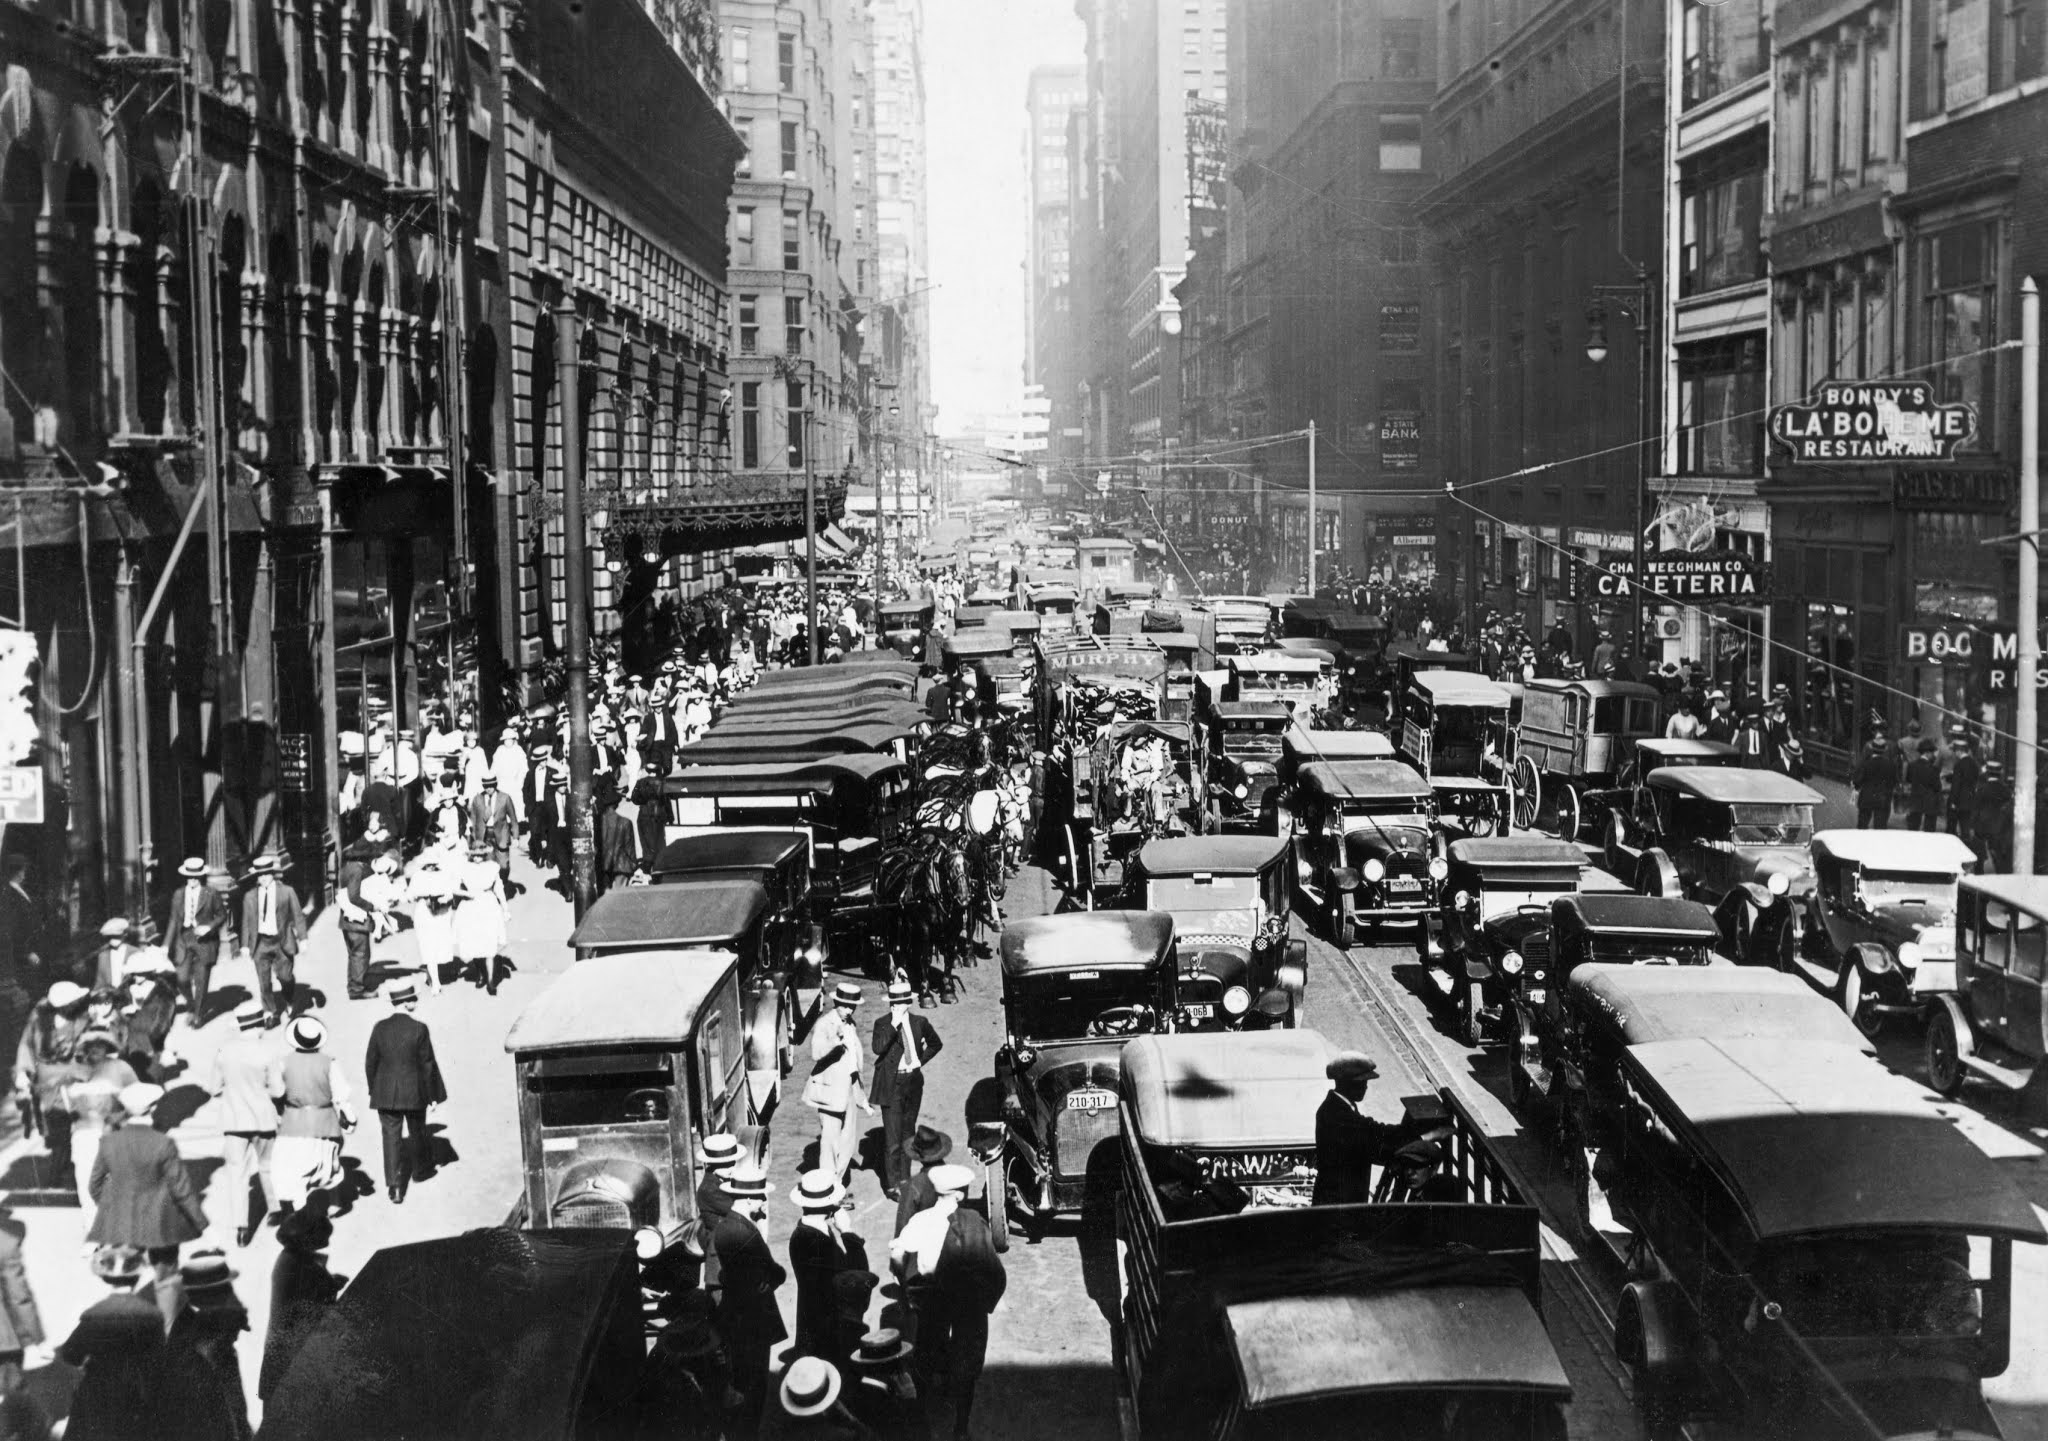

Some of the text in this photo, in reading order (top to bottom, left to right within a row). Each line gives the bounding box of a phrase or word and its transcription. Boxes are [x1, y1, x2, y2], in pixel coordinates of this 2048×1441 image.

[1827, 388, 1925, 406] BONDY'S
[1381, 428, 1419, 439] BANK
[1805, 440, 1945, 457] RESTAURANT
[1648, 562, 1721, 573] WEEGHMAN
[1725, 561, 1745, 572] CO.
[1051, 653, 1157, 670] MURPHY
[1069, 1095, 1107, 1108] 210-317
